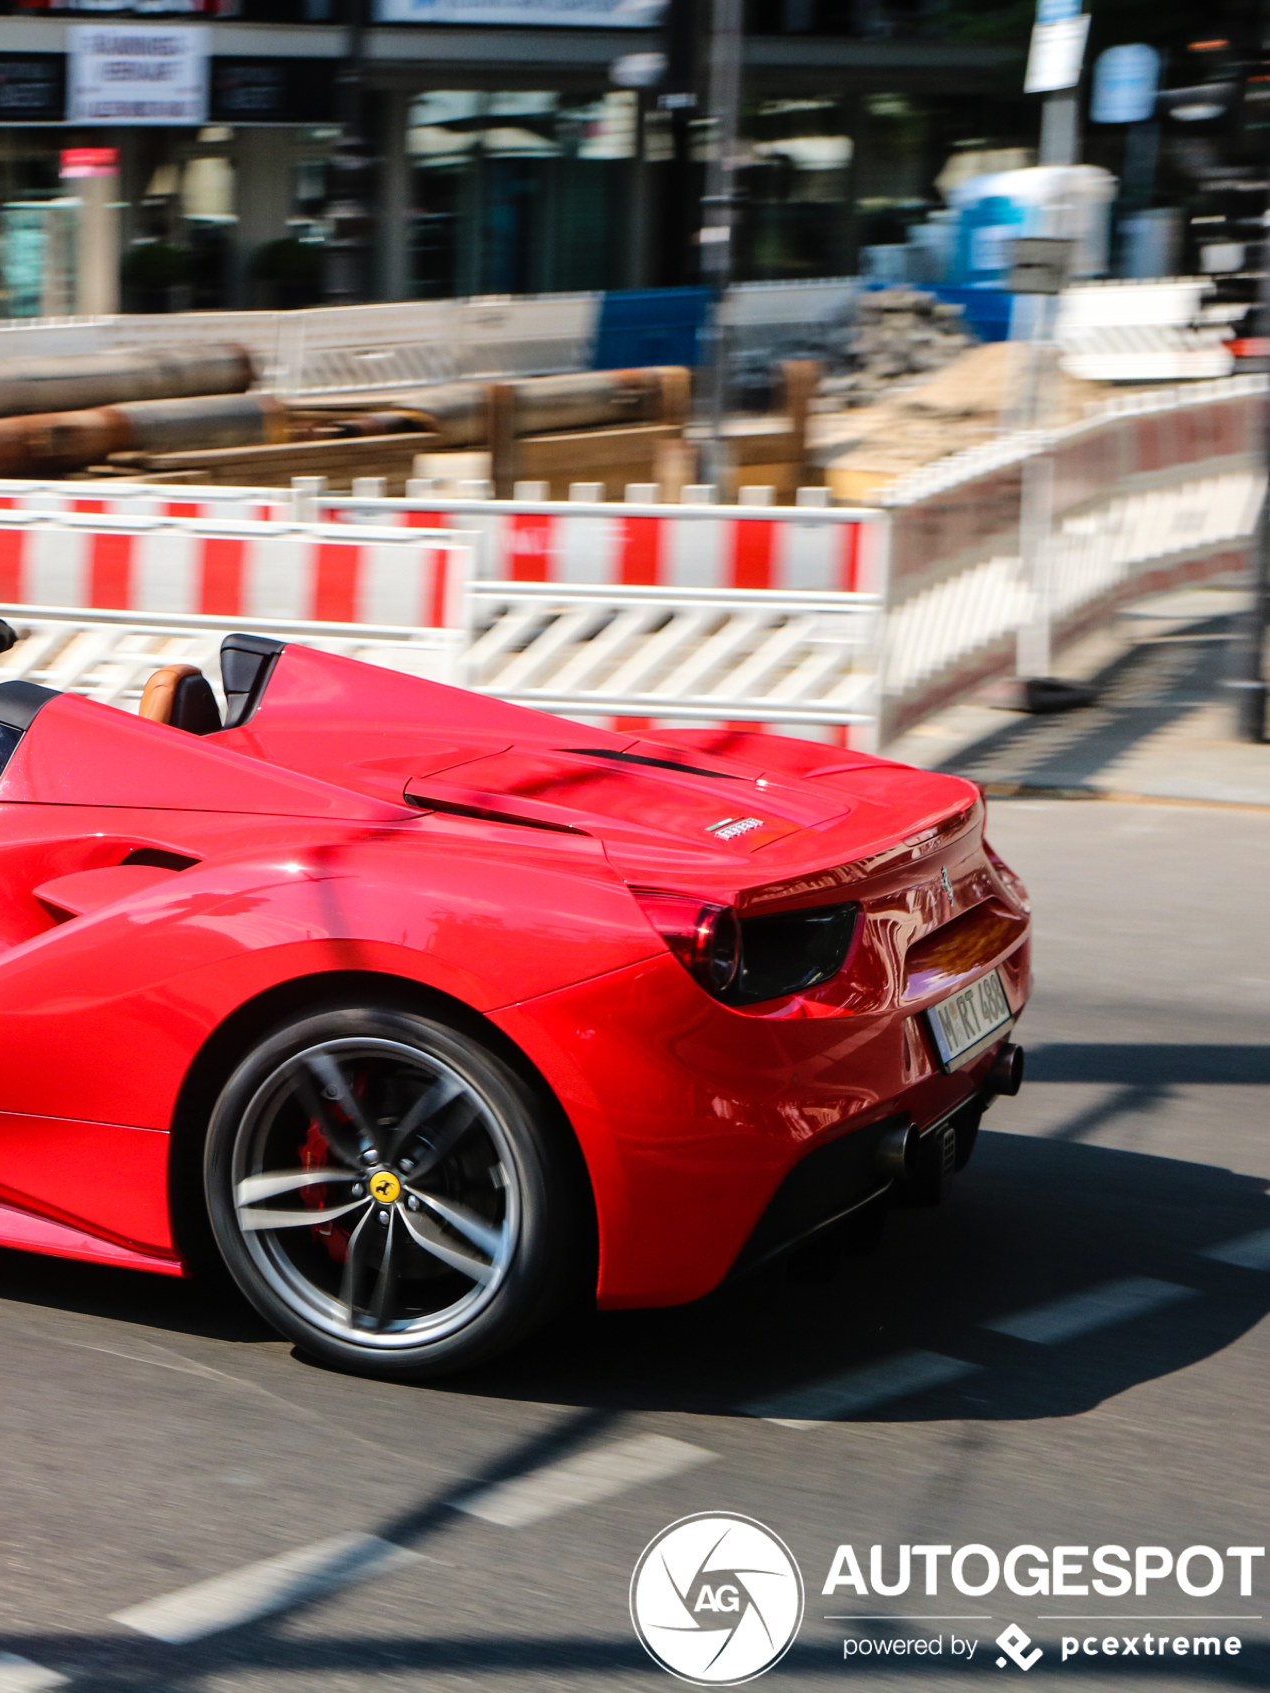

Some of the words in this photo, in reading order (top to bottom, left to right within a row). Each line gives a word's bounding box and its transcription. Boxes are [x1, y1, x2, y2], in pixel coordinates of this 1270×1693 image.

[938, 1006, 958, 1052] M
[957, 989, 981, 1040] RT
[978, 974, 1006, 1024] 488
